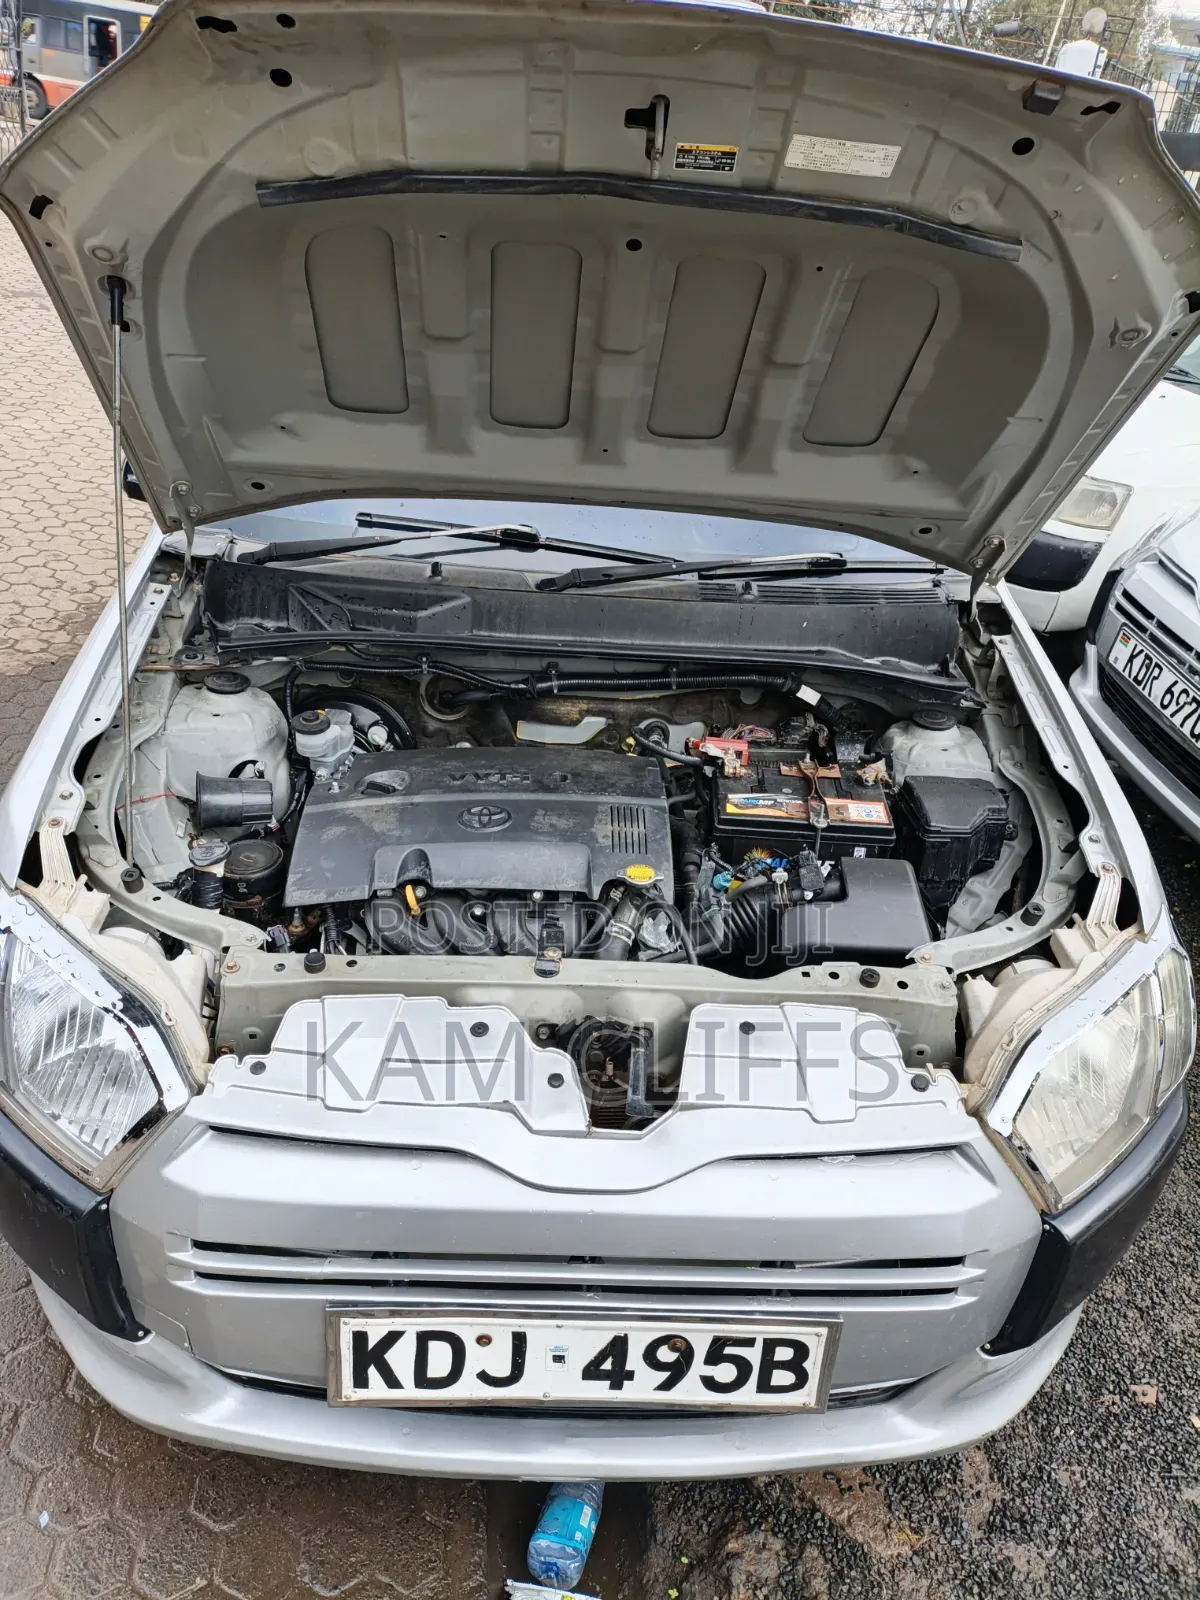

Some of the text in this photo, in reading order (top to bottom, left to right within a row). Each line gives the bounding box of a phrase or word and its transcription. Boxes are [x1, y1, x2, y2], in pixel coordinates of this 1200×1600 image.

[1122, 643, 1163, 697] KDR
[352, 1330, 811, 1395] KDJ 495B
